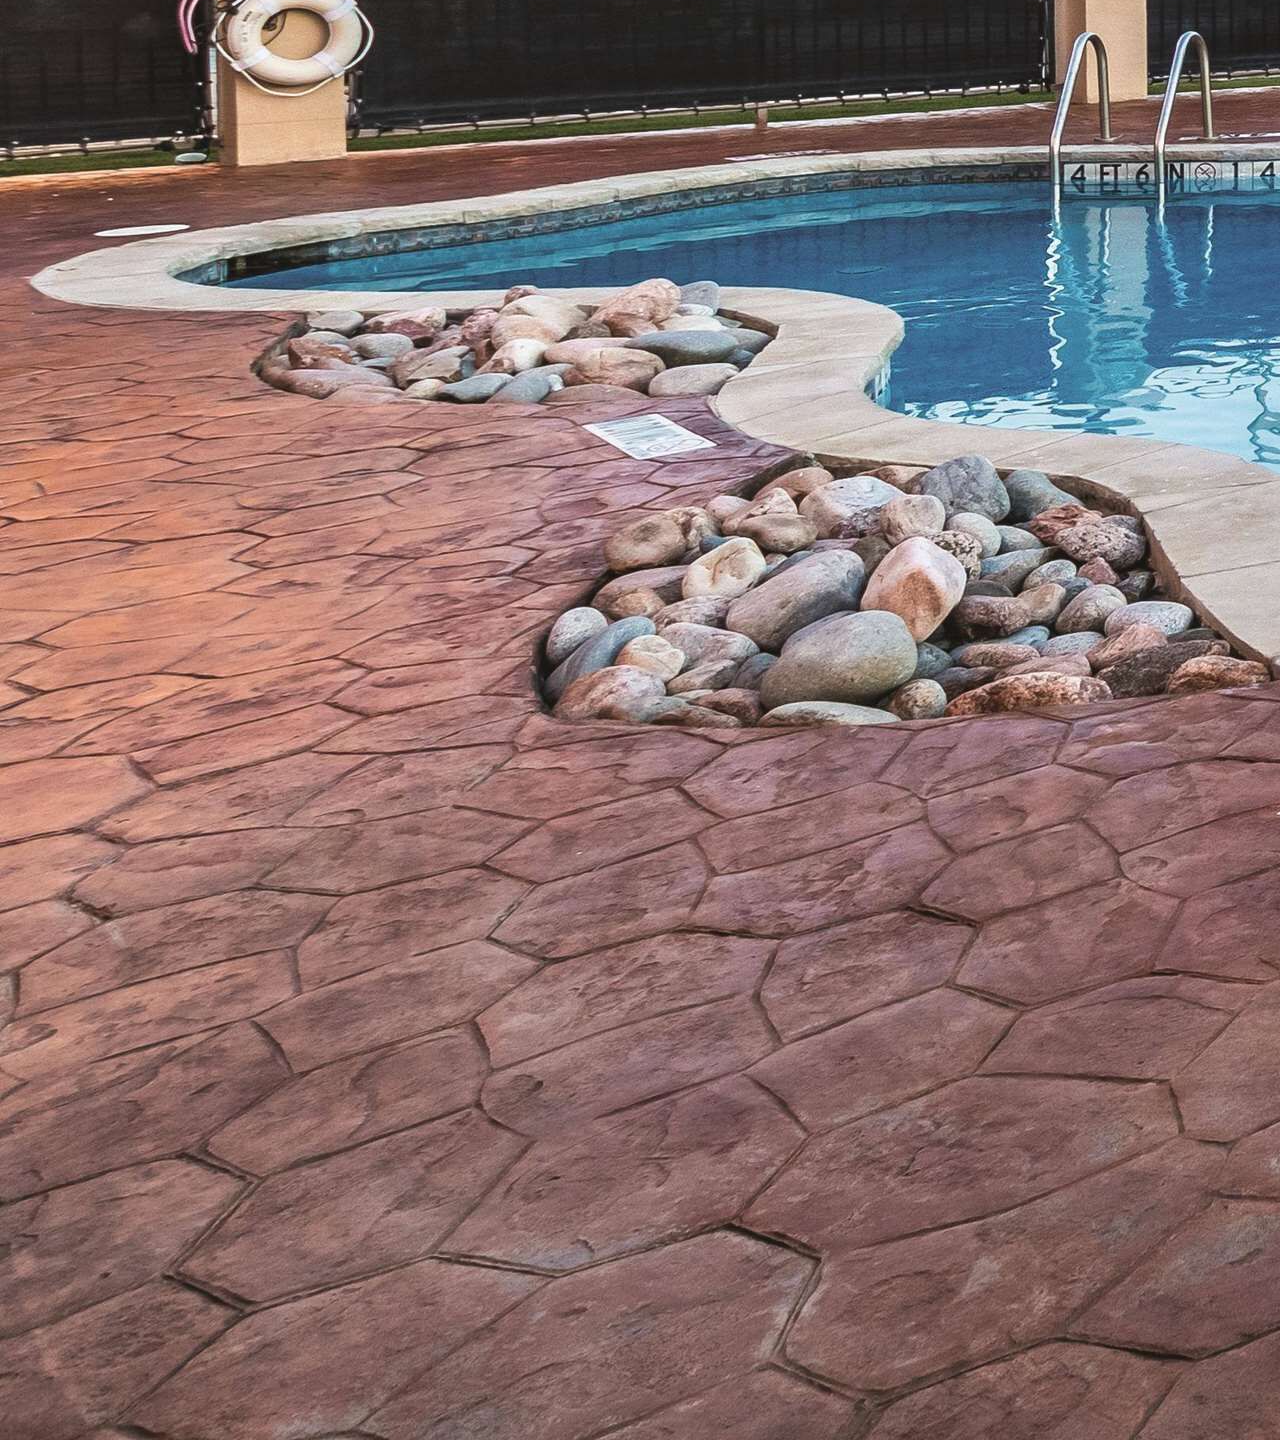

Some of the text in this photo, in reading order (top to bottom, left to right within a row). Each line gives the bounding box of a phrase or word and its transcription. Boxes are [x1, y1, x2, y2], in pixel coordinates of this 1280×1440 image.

[1070, 164, 1087, 181] 4
[1099, 163, 1122, 182] FT
[1135, 163, 1151, 182] 6
